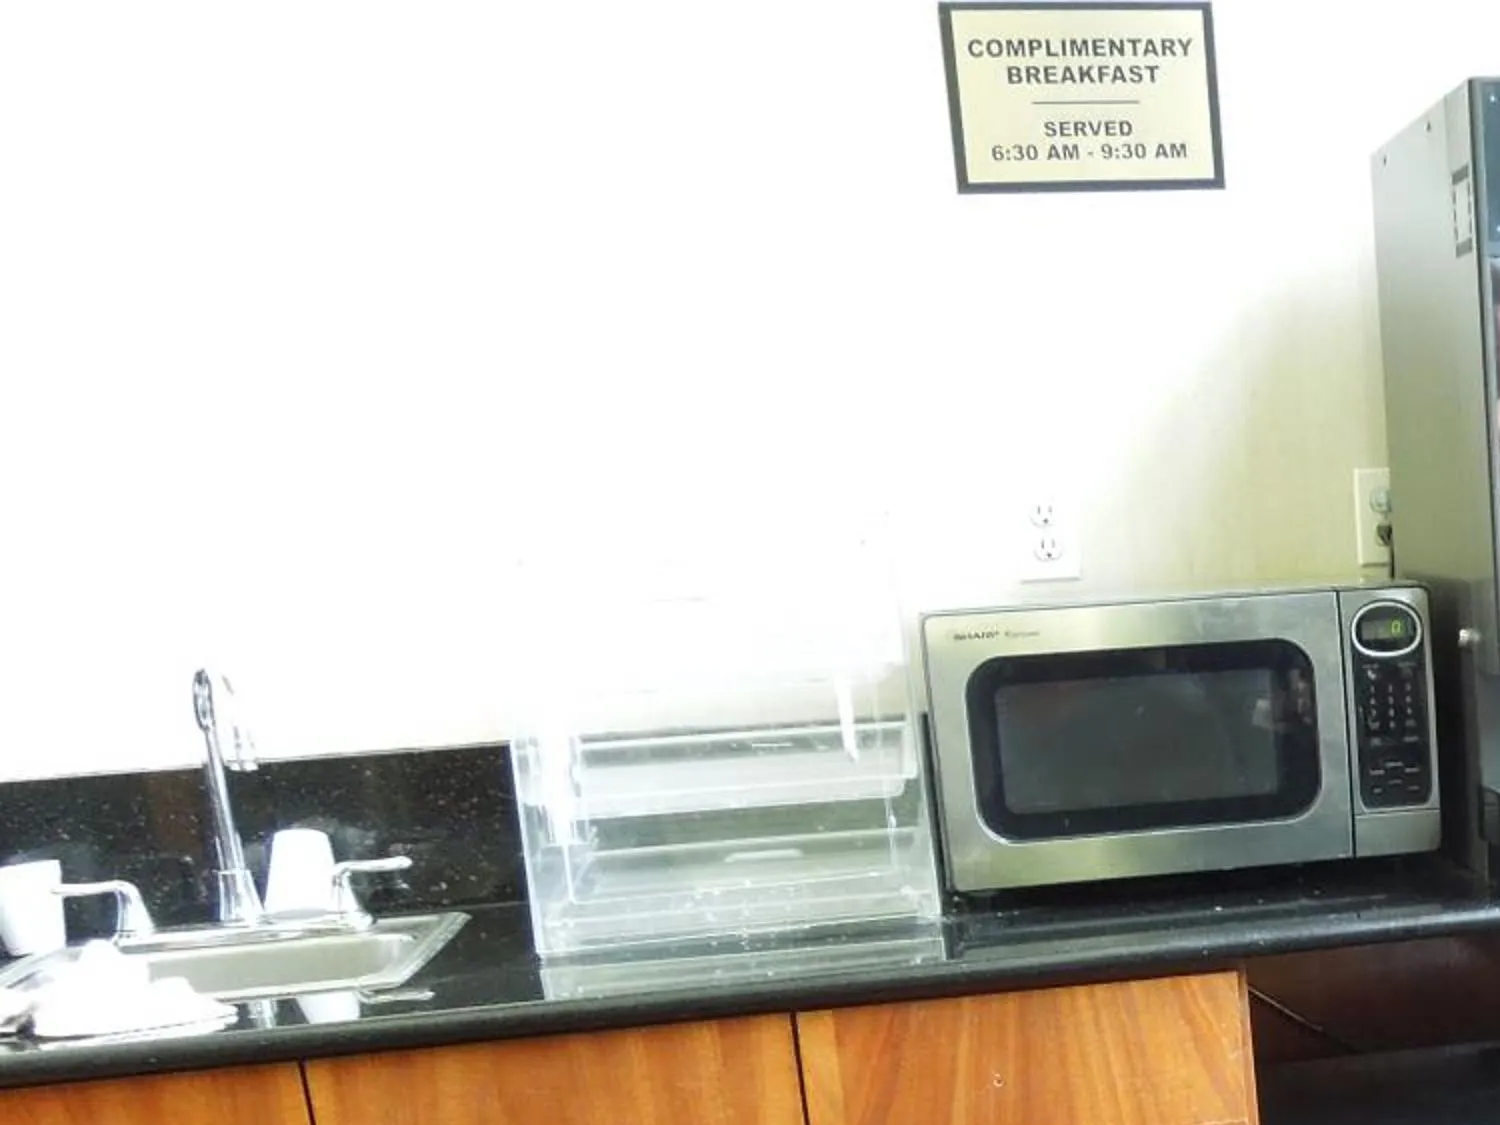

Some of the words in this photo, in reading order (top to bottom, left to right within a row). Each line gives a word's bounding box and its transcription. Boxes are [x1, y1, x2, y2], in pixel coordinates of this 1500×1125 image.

[967, 38, 1193, 58] COMPLIMENTARY
[1007, 65, 1160, 85] BREAKFAST
[1043, 120, 1133, 138] SERVED
[991, 144, 1039, 162] 6:30
[1046, 144, 1080, 161] AM
[1101, 143, 1147, 161] 9:30
[1155, 143, 1188, 160] AM
